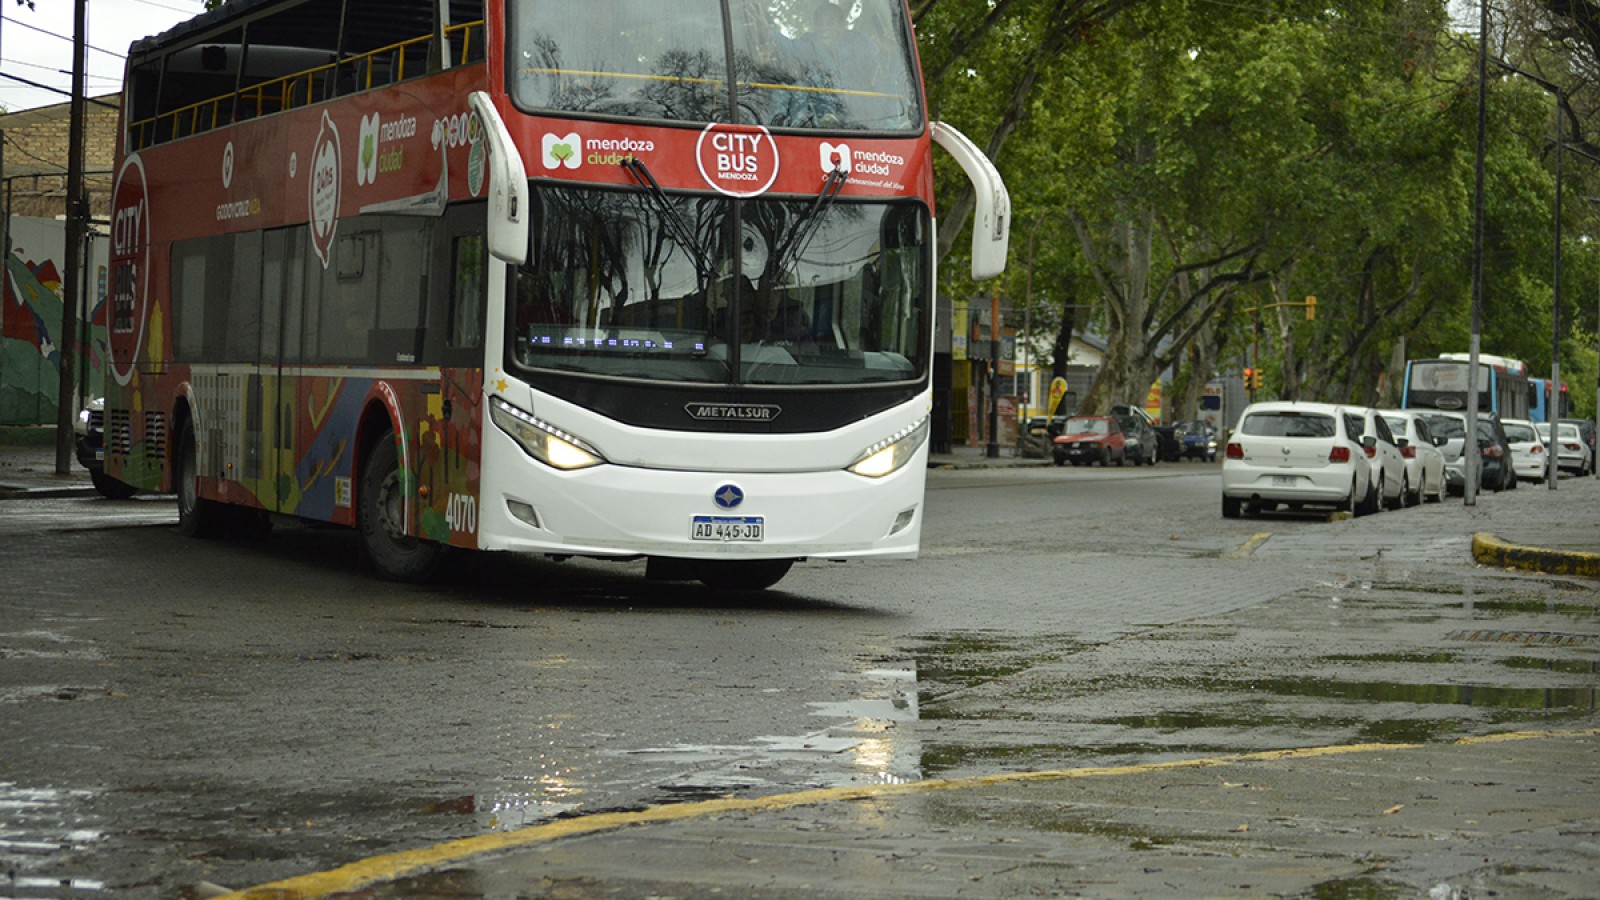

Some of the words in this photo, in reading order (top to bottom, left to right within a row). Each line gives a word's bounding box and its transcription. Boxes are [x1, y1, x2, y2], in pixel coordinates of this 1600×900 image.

[380, 112, 417, 143] mendoza
[586, 137, 655, 151] mendoza
[712, 133, 762, 153] CITY
[587, 151, 633, 165] ciudad
[717, 153, 758, 173] BUS
[854, 150, 904, 165] mendoza
[855, 161, 889, 176] ciudad
[718, 172, 758, 181] MENDOZA
[114, 198, 143, 256] CITY
[696, 406, 770, 418] METALSUR
[445, 492, 476, 534] 4070
[696, 523, 713, 537] AD
